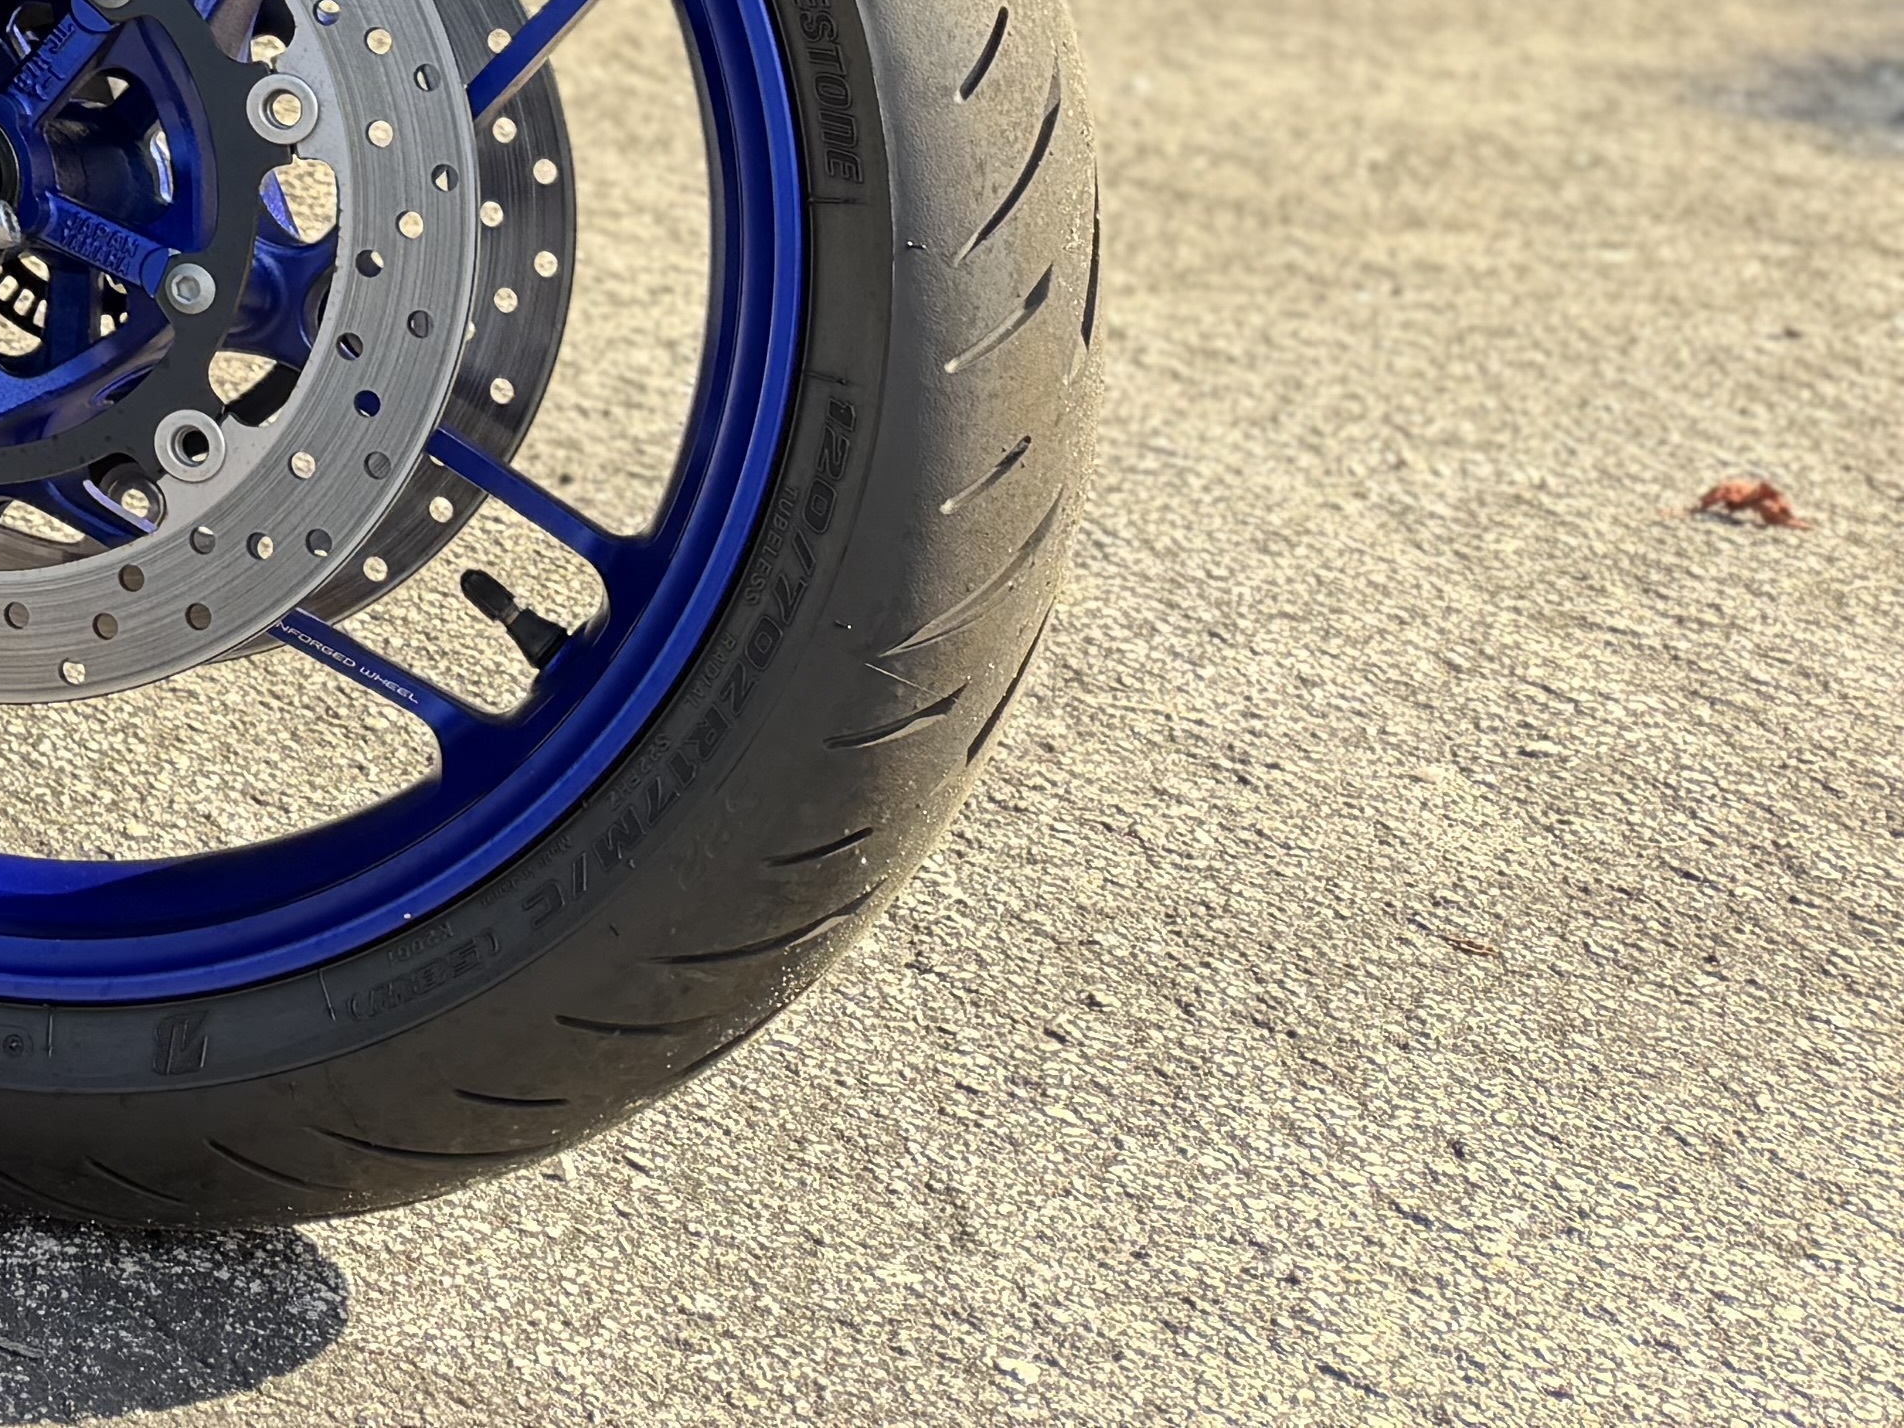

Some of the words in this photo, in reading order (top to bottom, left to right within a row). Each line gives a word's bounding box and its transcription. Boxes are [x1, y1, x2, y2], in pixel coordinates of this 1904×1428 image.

[63, 211, 141, 259] JAPAN
[742, 485, 800, 608] TUBELESS
[274, 620, 358, 668] NFORGED
[358, 665, 420, 705] WHEEL
[682, 630, 737, 712] RADIAL
